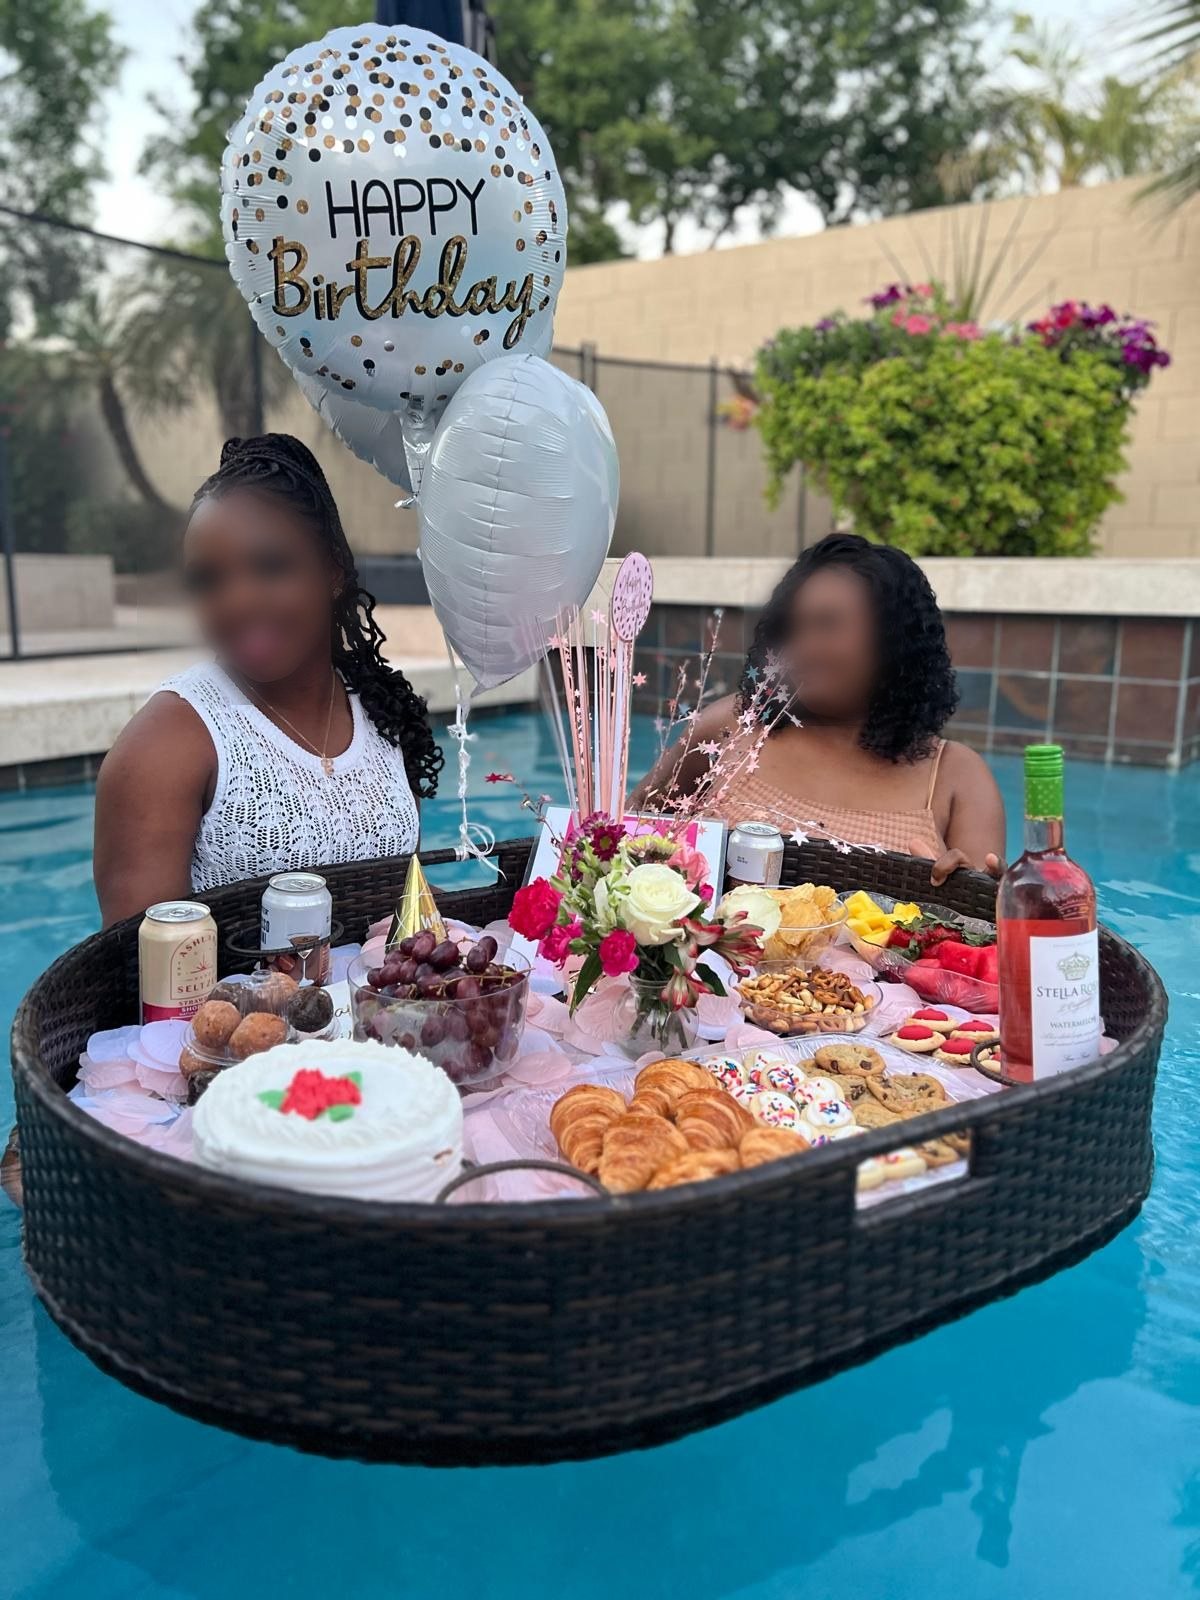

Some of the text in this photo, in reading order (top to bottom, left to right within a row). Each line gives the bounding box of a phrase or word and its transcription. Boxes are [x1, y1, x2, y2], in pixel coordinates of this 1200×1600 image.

[325, 178, 486, 238] HAPPY
[267, 235, 535, 350] Birthday
[1036, 985, 1079, 1000] STELLA
